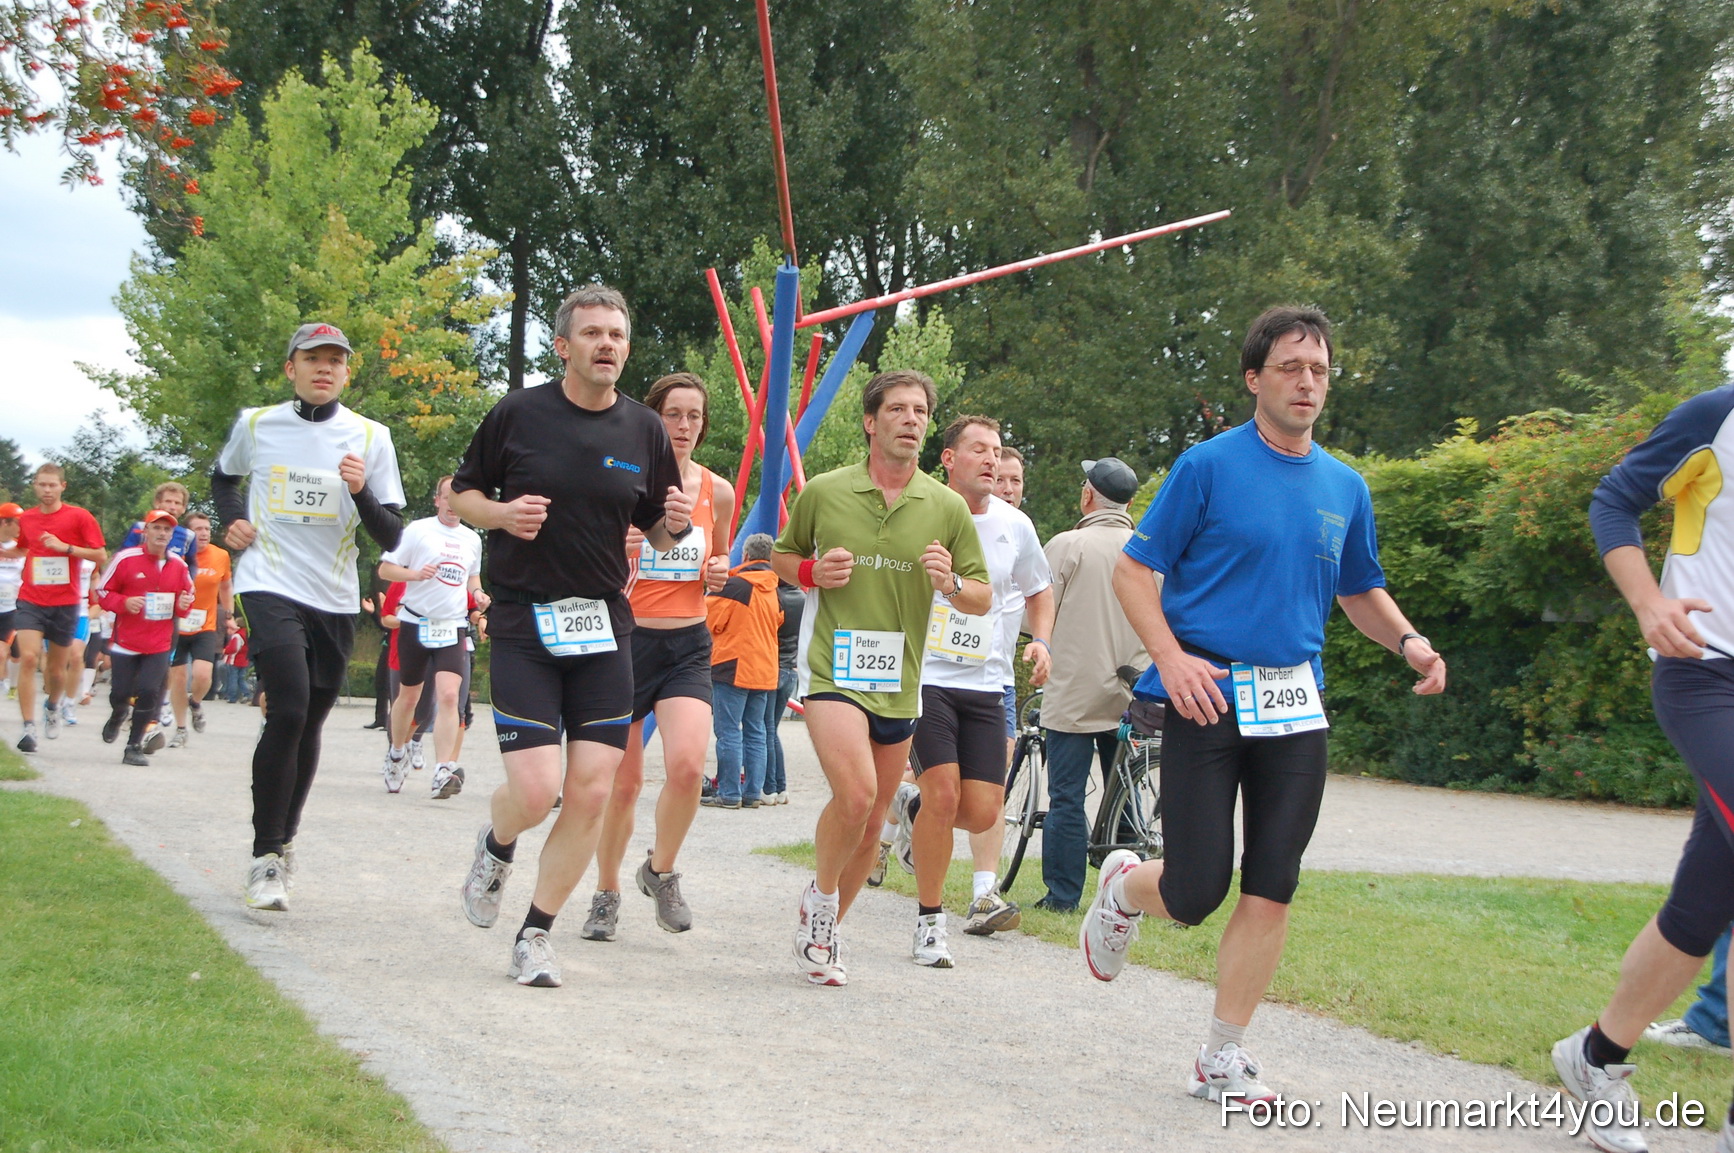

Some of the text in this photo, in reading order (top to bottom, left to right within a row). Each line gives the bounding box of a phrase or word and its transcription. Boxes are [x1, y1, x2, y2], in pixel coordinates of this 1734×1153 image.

[288, 471, 322, 485] Markus
[294, 490, 328, 507] 357
[661, 547, 698, 561] 2883
[853, 555, 914, 572] URO POLES
[46, 567, 63, 576] 122
[558, 601, 600, 613] Wolfgang
[544, 618, 551, 626] B
[564, 615, 604, 633] 2603
[949, 613, 968, 626] Paul
[431, 628, 453, 638] 2271
[931, 624, 937, 632] C
[856, 636, 881, 649] Peter
[951, 631, 981, 649] 829
[855, 654, 897, 671] 3252
[1258, 668, 1294, 681] Norbert
[1239, 691, 1246, 701] C
[1262, 688, 1308, 709] 2499
